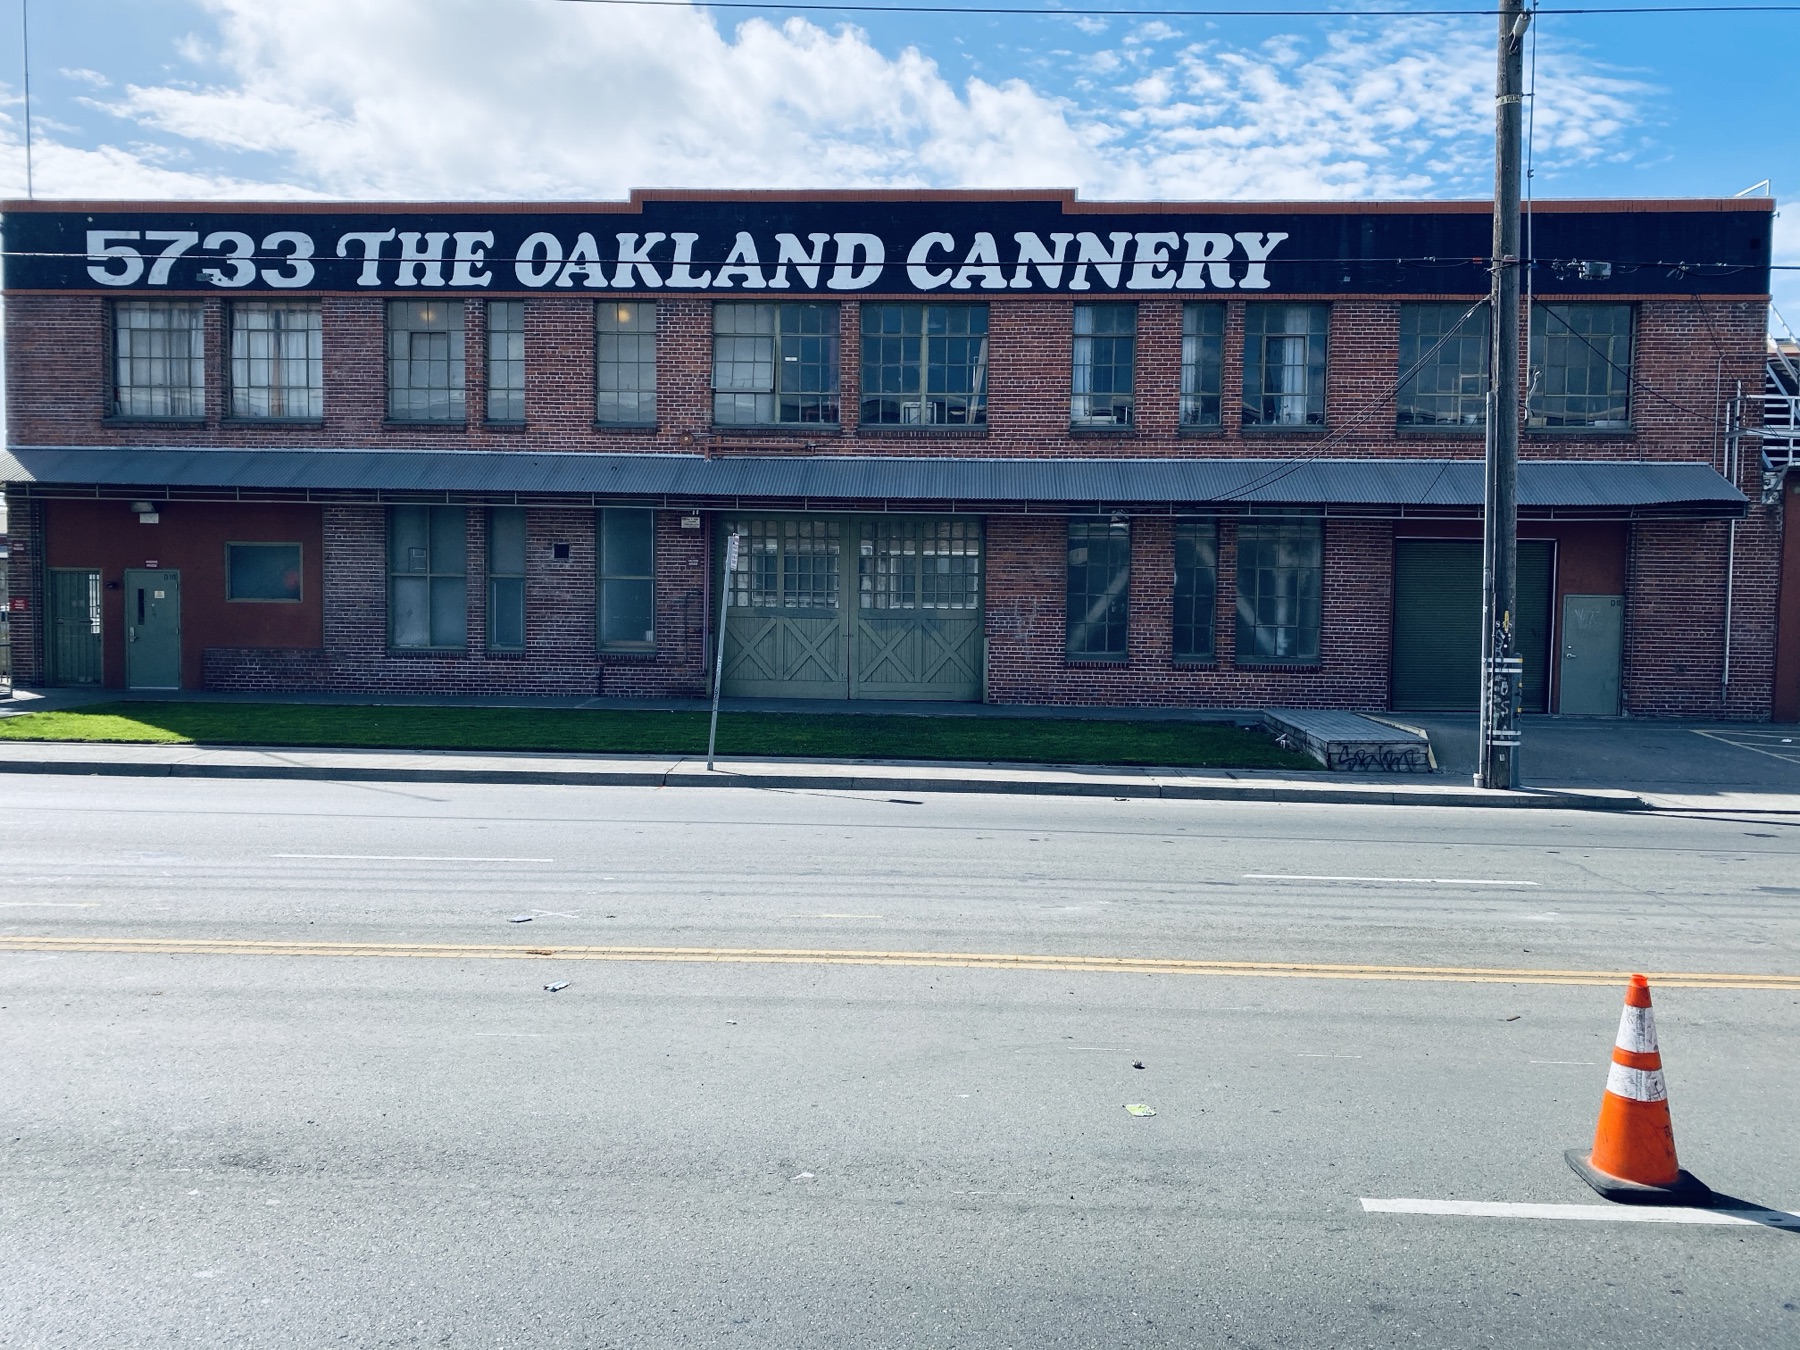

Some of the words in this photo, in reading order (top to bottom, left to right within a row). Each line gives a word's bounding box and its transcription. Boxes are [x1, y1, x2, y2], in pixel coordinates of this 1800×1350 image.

[86, 230, 316, 288] 5733
[337, 228, 495, 288] THE
[514, 231, 885, 290] OAKLAND
[906, 231, 1289, 290] CANNERY
